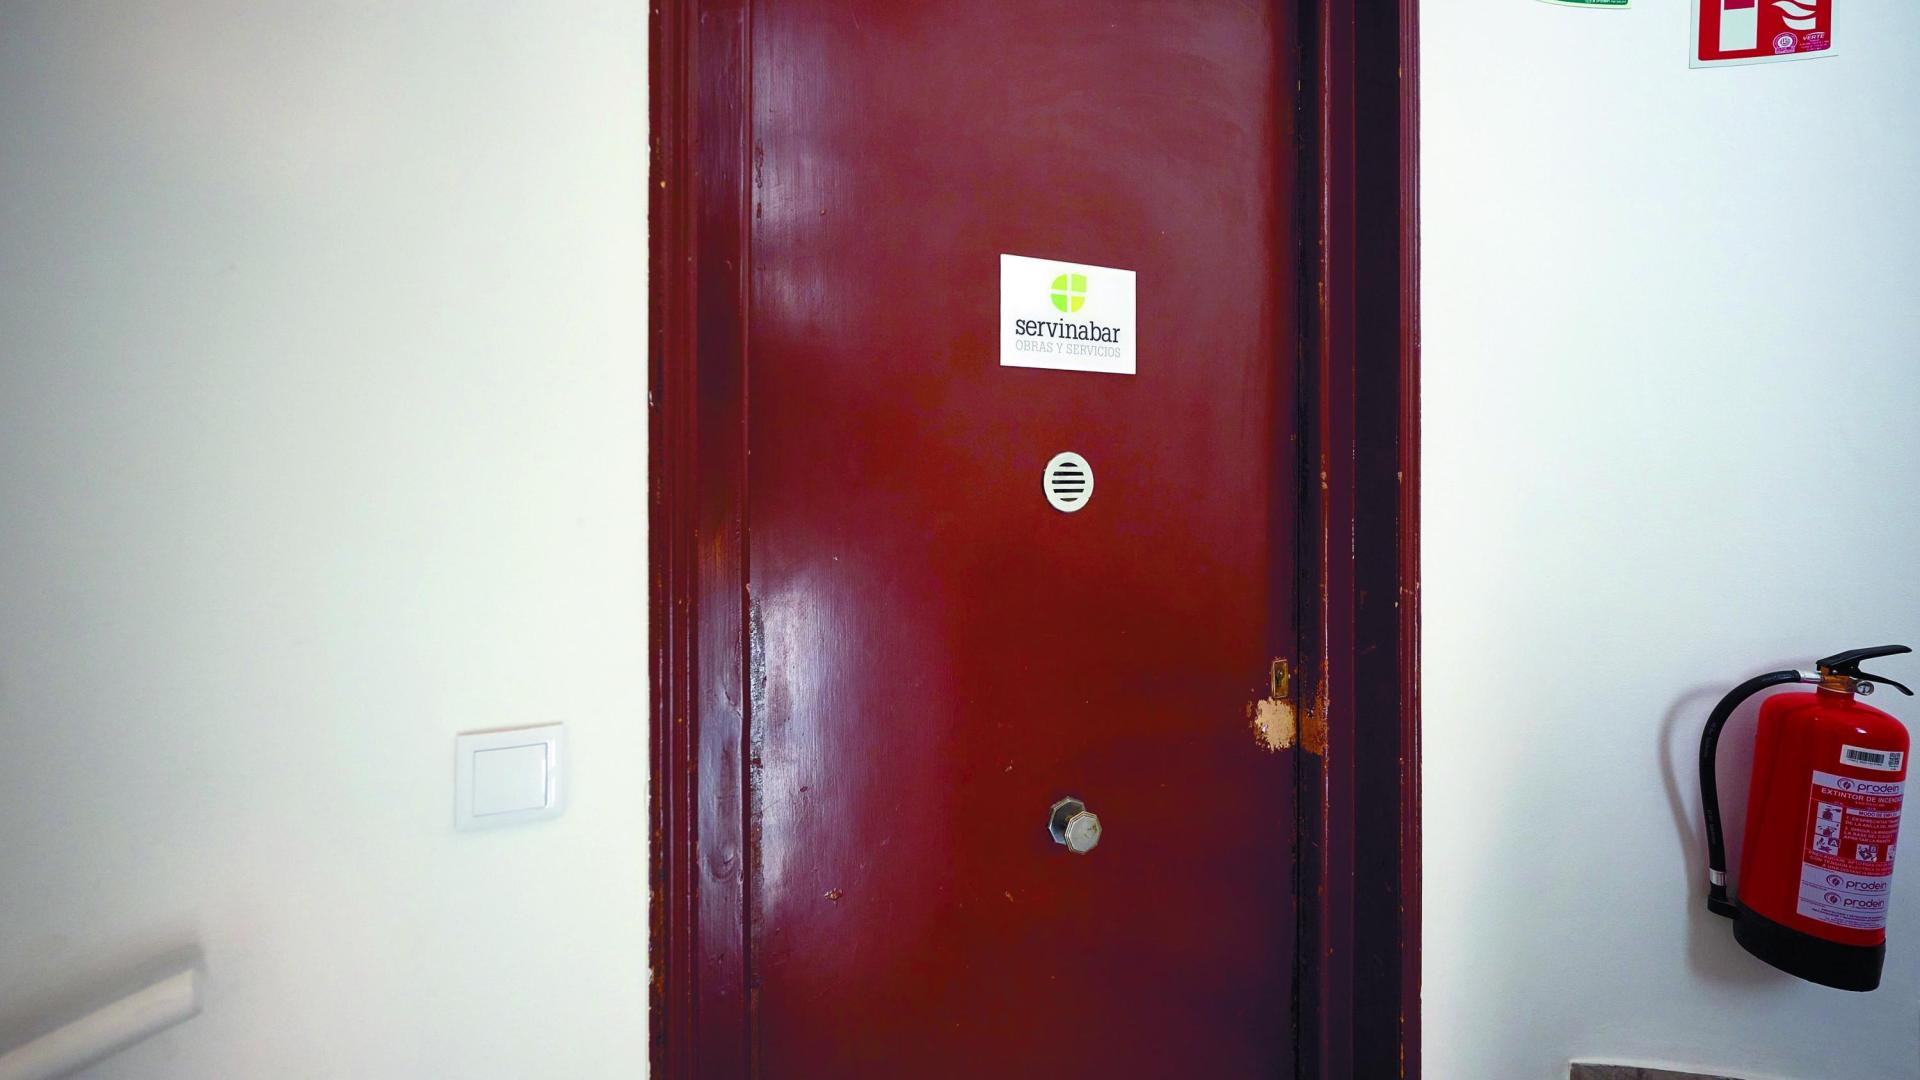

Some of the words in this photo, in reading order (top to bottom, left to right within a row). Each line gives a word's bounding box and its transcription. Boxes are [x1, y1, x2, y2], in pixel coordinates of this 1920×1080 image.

[1016, 318, 1121, 343] servinabar
[1016, 339, 1053, 353] OBRAS
[1056, 342, 1063, 354] Y
[1066, 343, 1121, 358] SERVICIOS
[1821, 787, 1864, 801] EXTINTOR
